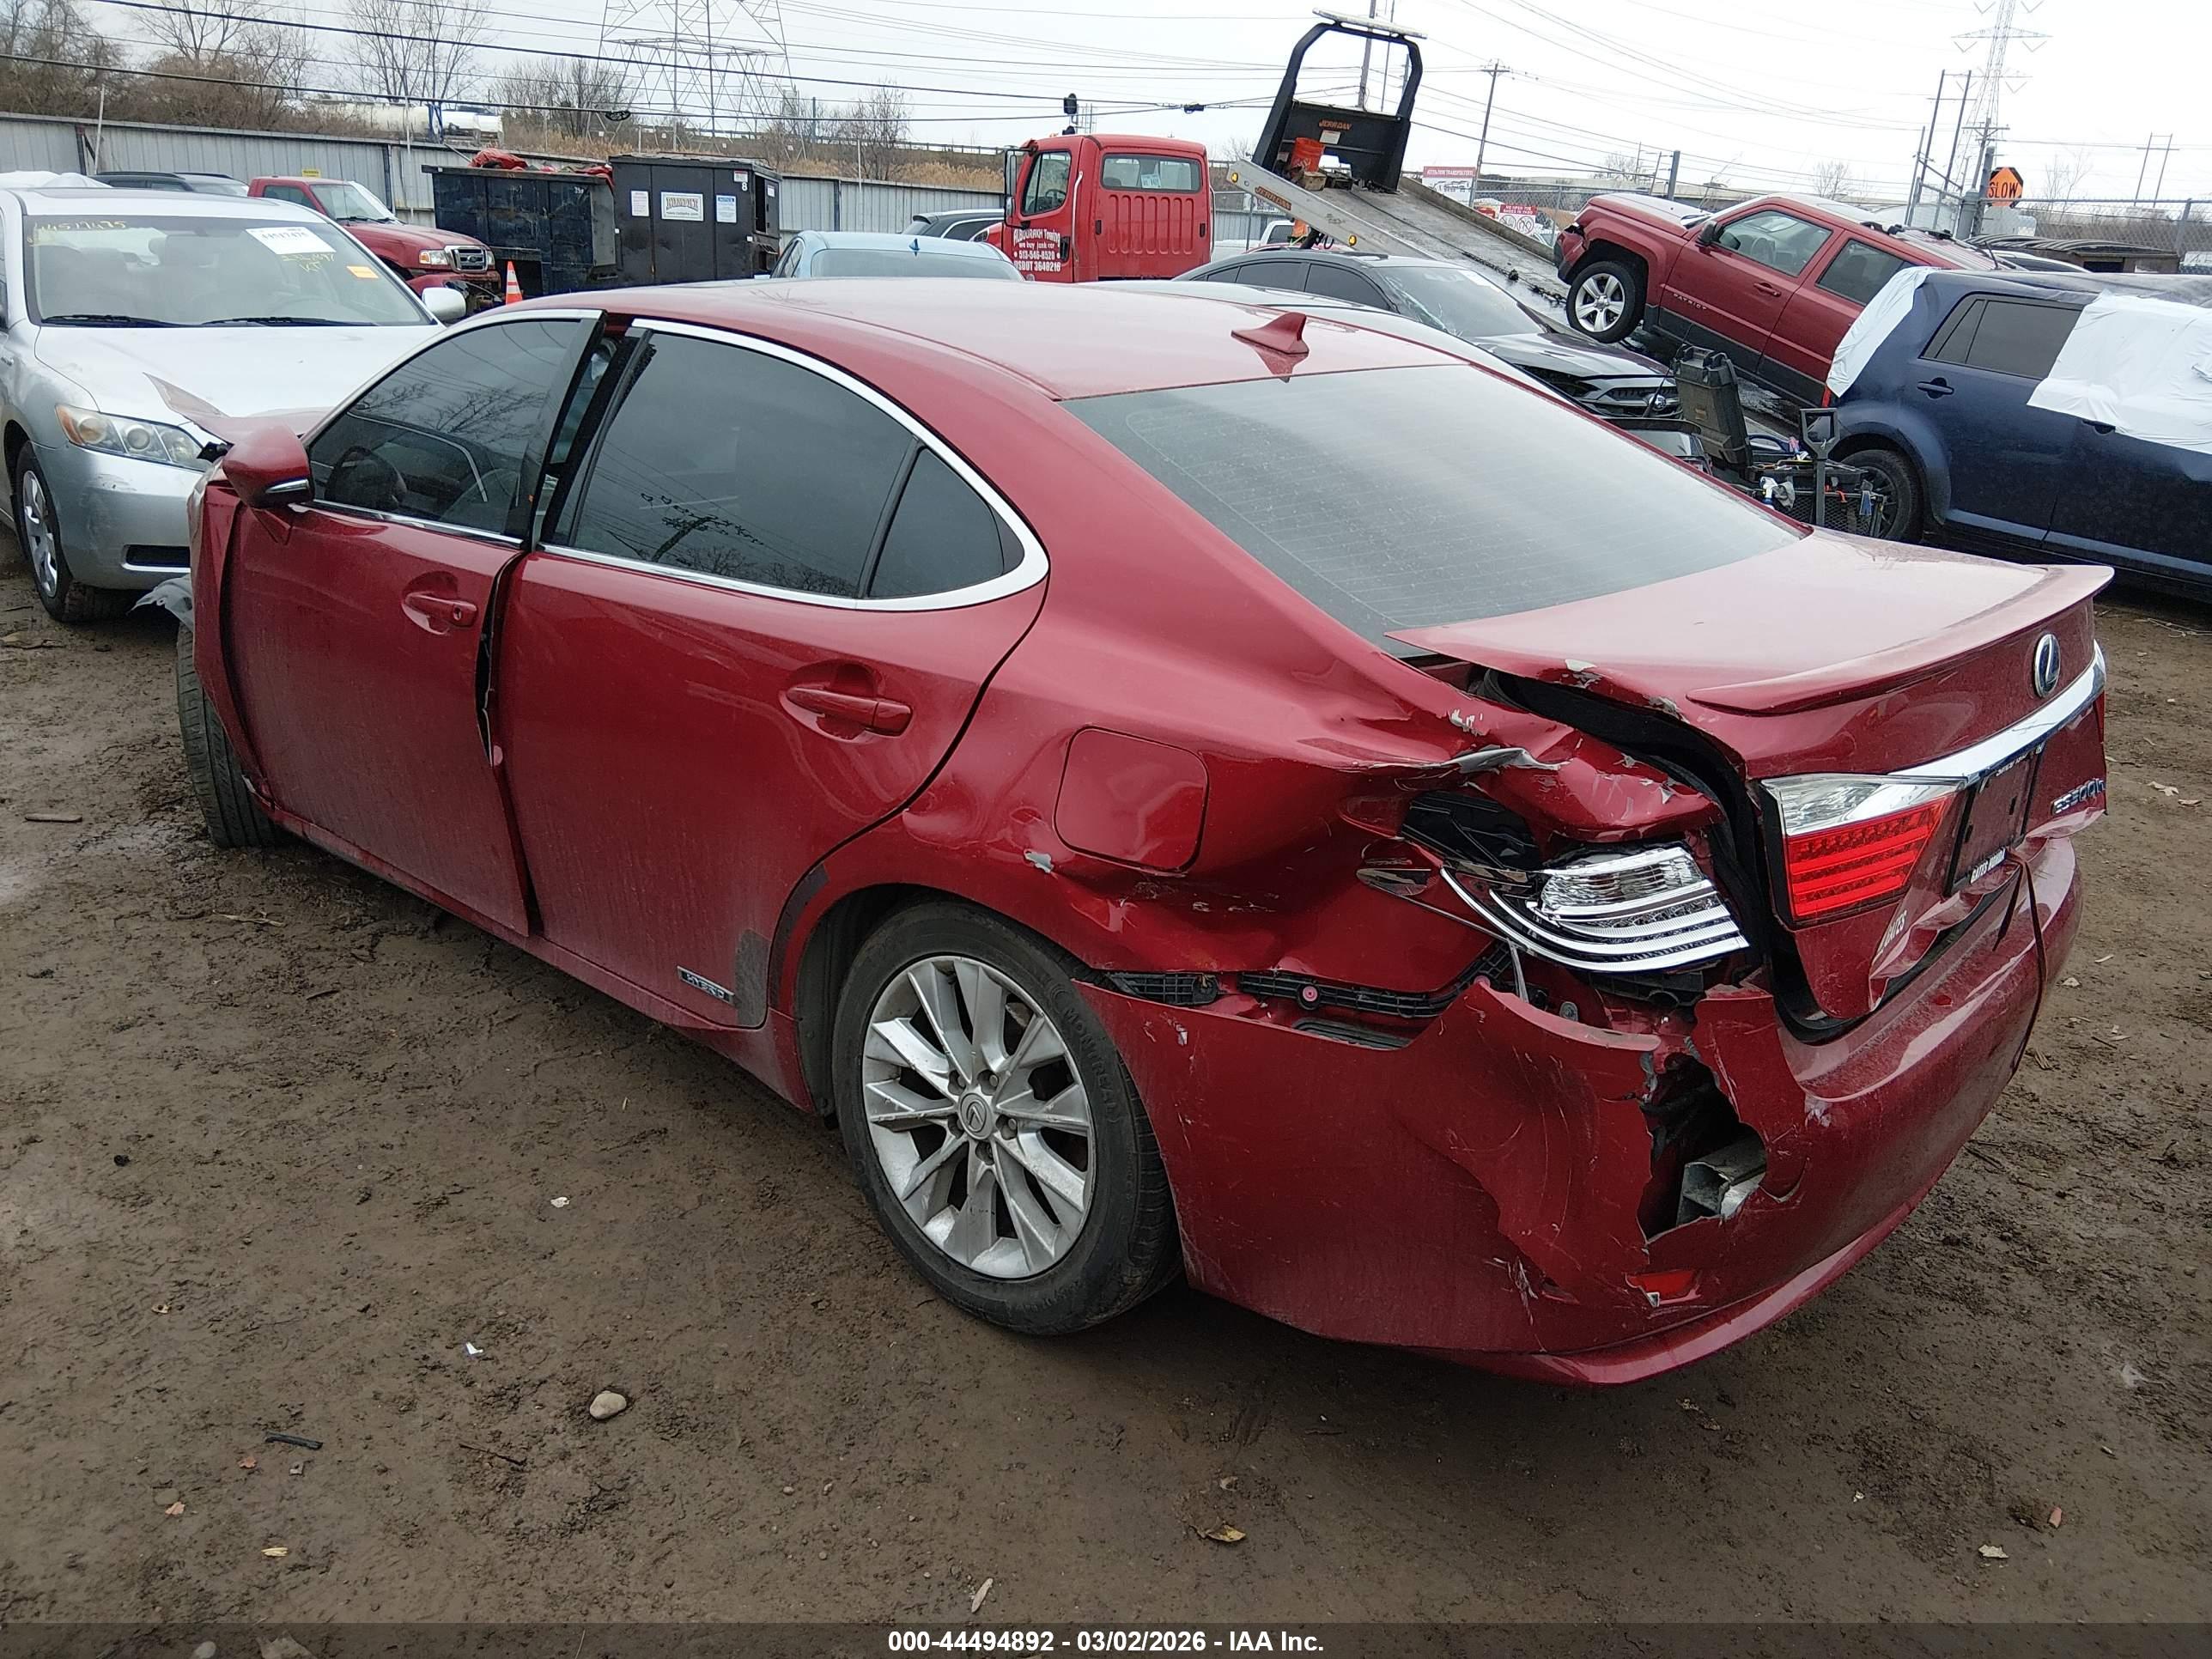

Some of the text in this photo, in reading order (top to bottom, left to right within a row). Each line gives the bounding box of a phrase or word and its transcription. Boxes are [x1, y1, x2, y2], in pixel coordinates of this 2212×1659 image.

[741, 182, 748, 191] 8
[1989, 181, 2019, 198] SLOW
[1026, 241, 1036, 250] buy
[1037, 241, 1047, 251] junk
[1674, 293, 1707, 310] PATRIOT
[1063, 1006, 1118, 1114] MONTREAL
